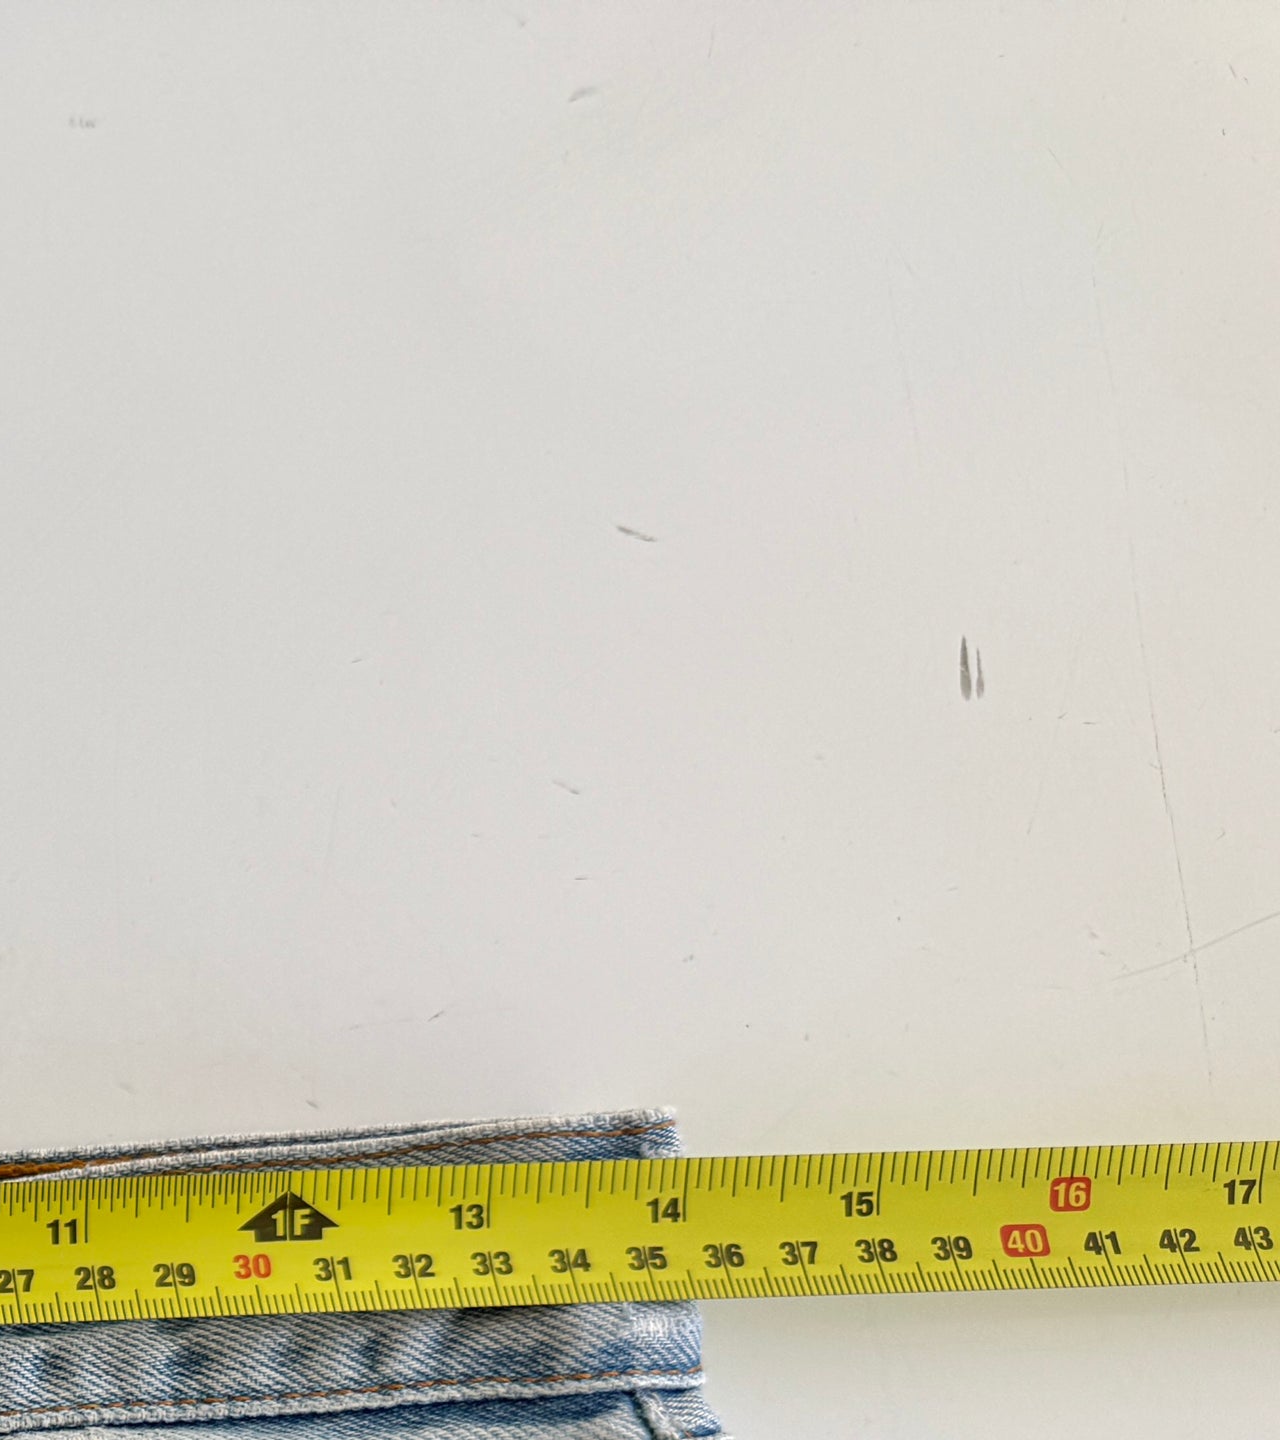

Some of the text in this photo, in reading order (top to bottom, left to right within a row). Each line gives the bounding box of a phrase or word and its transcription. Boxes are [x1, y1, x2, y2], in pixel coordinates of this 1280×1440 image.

[46, 1218, 78, 1245] 11
[271, 1208, 312, 1237] 1F
[449, 1203, 485, 1230] 13
[646, 1197, 680, 1223] 14
[840, 1191, 874, 1217] 15
[1052, 1181, 1087, 1208] 16
[1223, 1179, 1256, 1205] 17
[74, 1265, 116, 1290] 28
[153, 1262, 196, 1288] 29
[232, 1253, 272, 1280] 30
[313, 1256, 352, 1282] 31
[392, 1253, 436, 1279] 32
[471, 1251, 513, 1276] 33
[548, 1248, 591, 1274] 34
[625, 1246, 668, 1271] 35
[702, 1243, 745, 1269] 36
[779, 1240, 818, 1266] 37
[854, 1238, 898, 1263] 38
[931, 1235, 973, 1261] 39
[1006, 1229, 1044, 1253] 40
[1084, 1230, 1122, 1256] 41
[1159, 1228, 1200, 1253] 42
[1233, 1226, 1274, 1251] 43
